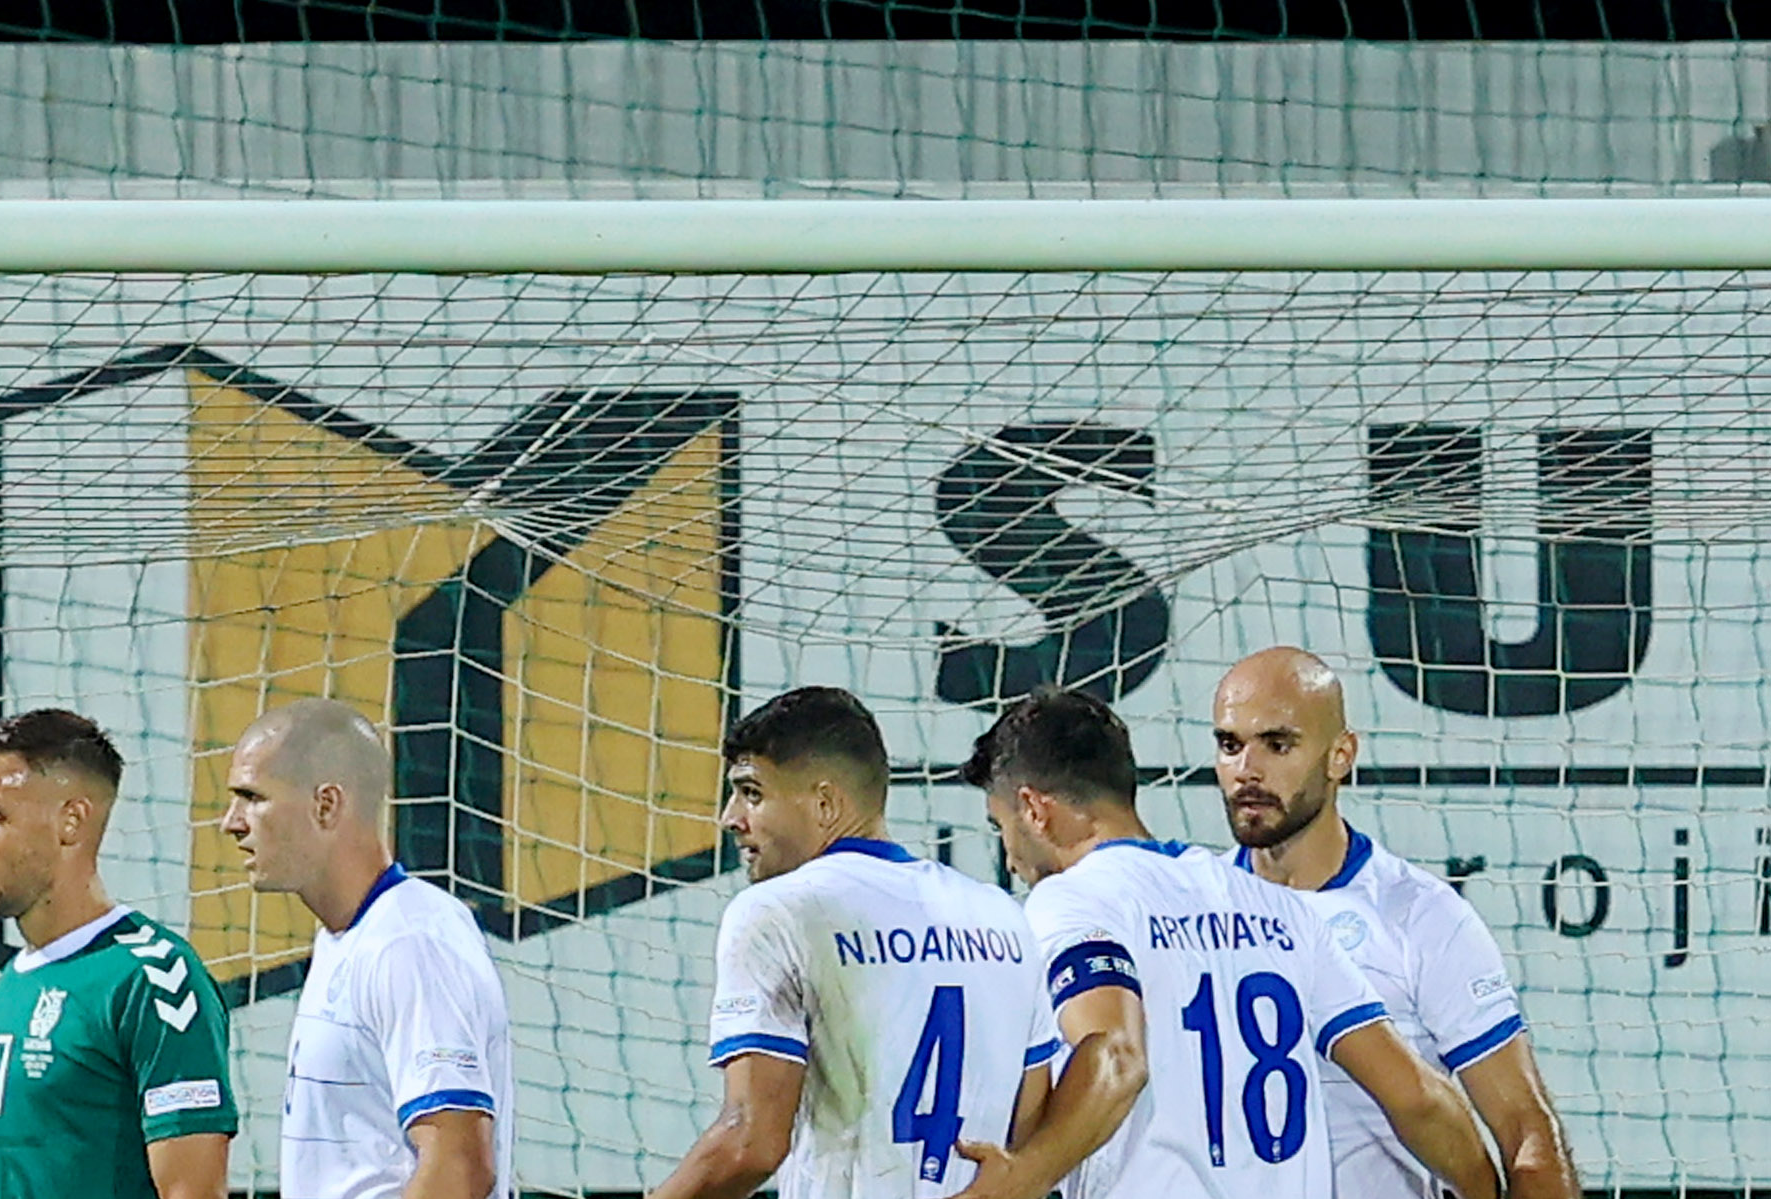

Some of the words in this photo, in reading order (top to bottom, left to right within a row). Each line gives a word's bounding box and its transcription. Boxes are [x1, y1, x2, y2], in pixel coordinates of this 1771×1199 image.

[834, 926, 1023, 966] N.IOANNOU
[893, 985, 964, 1183] 4
[1181, 972, 1307, 1167] 18
